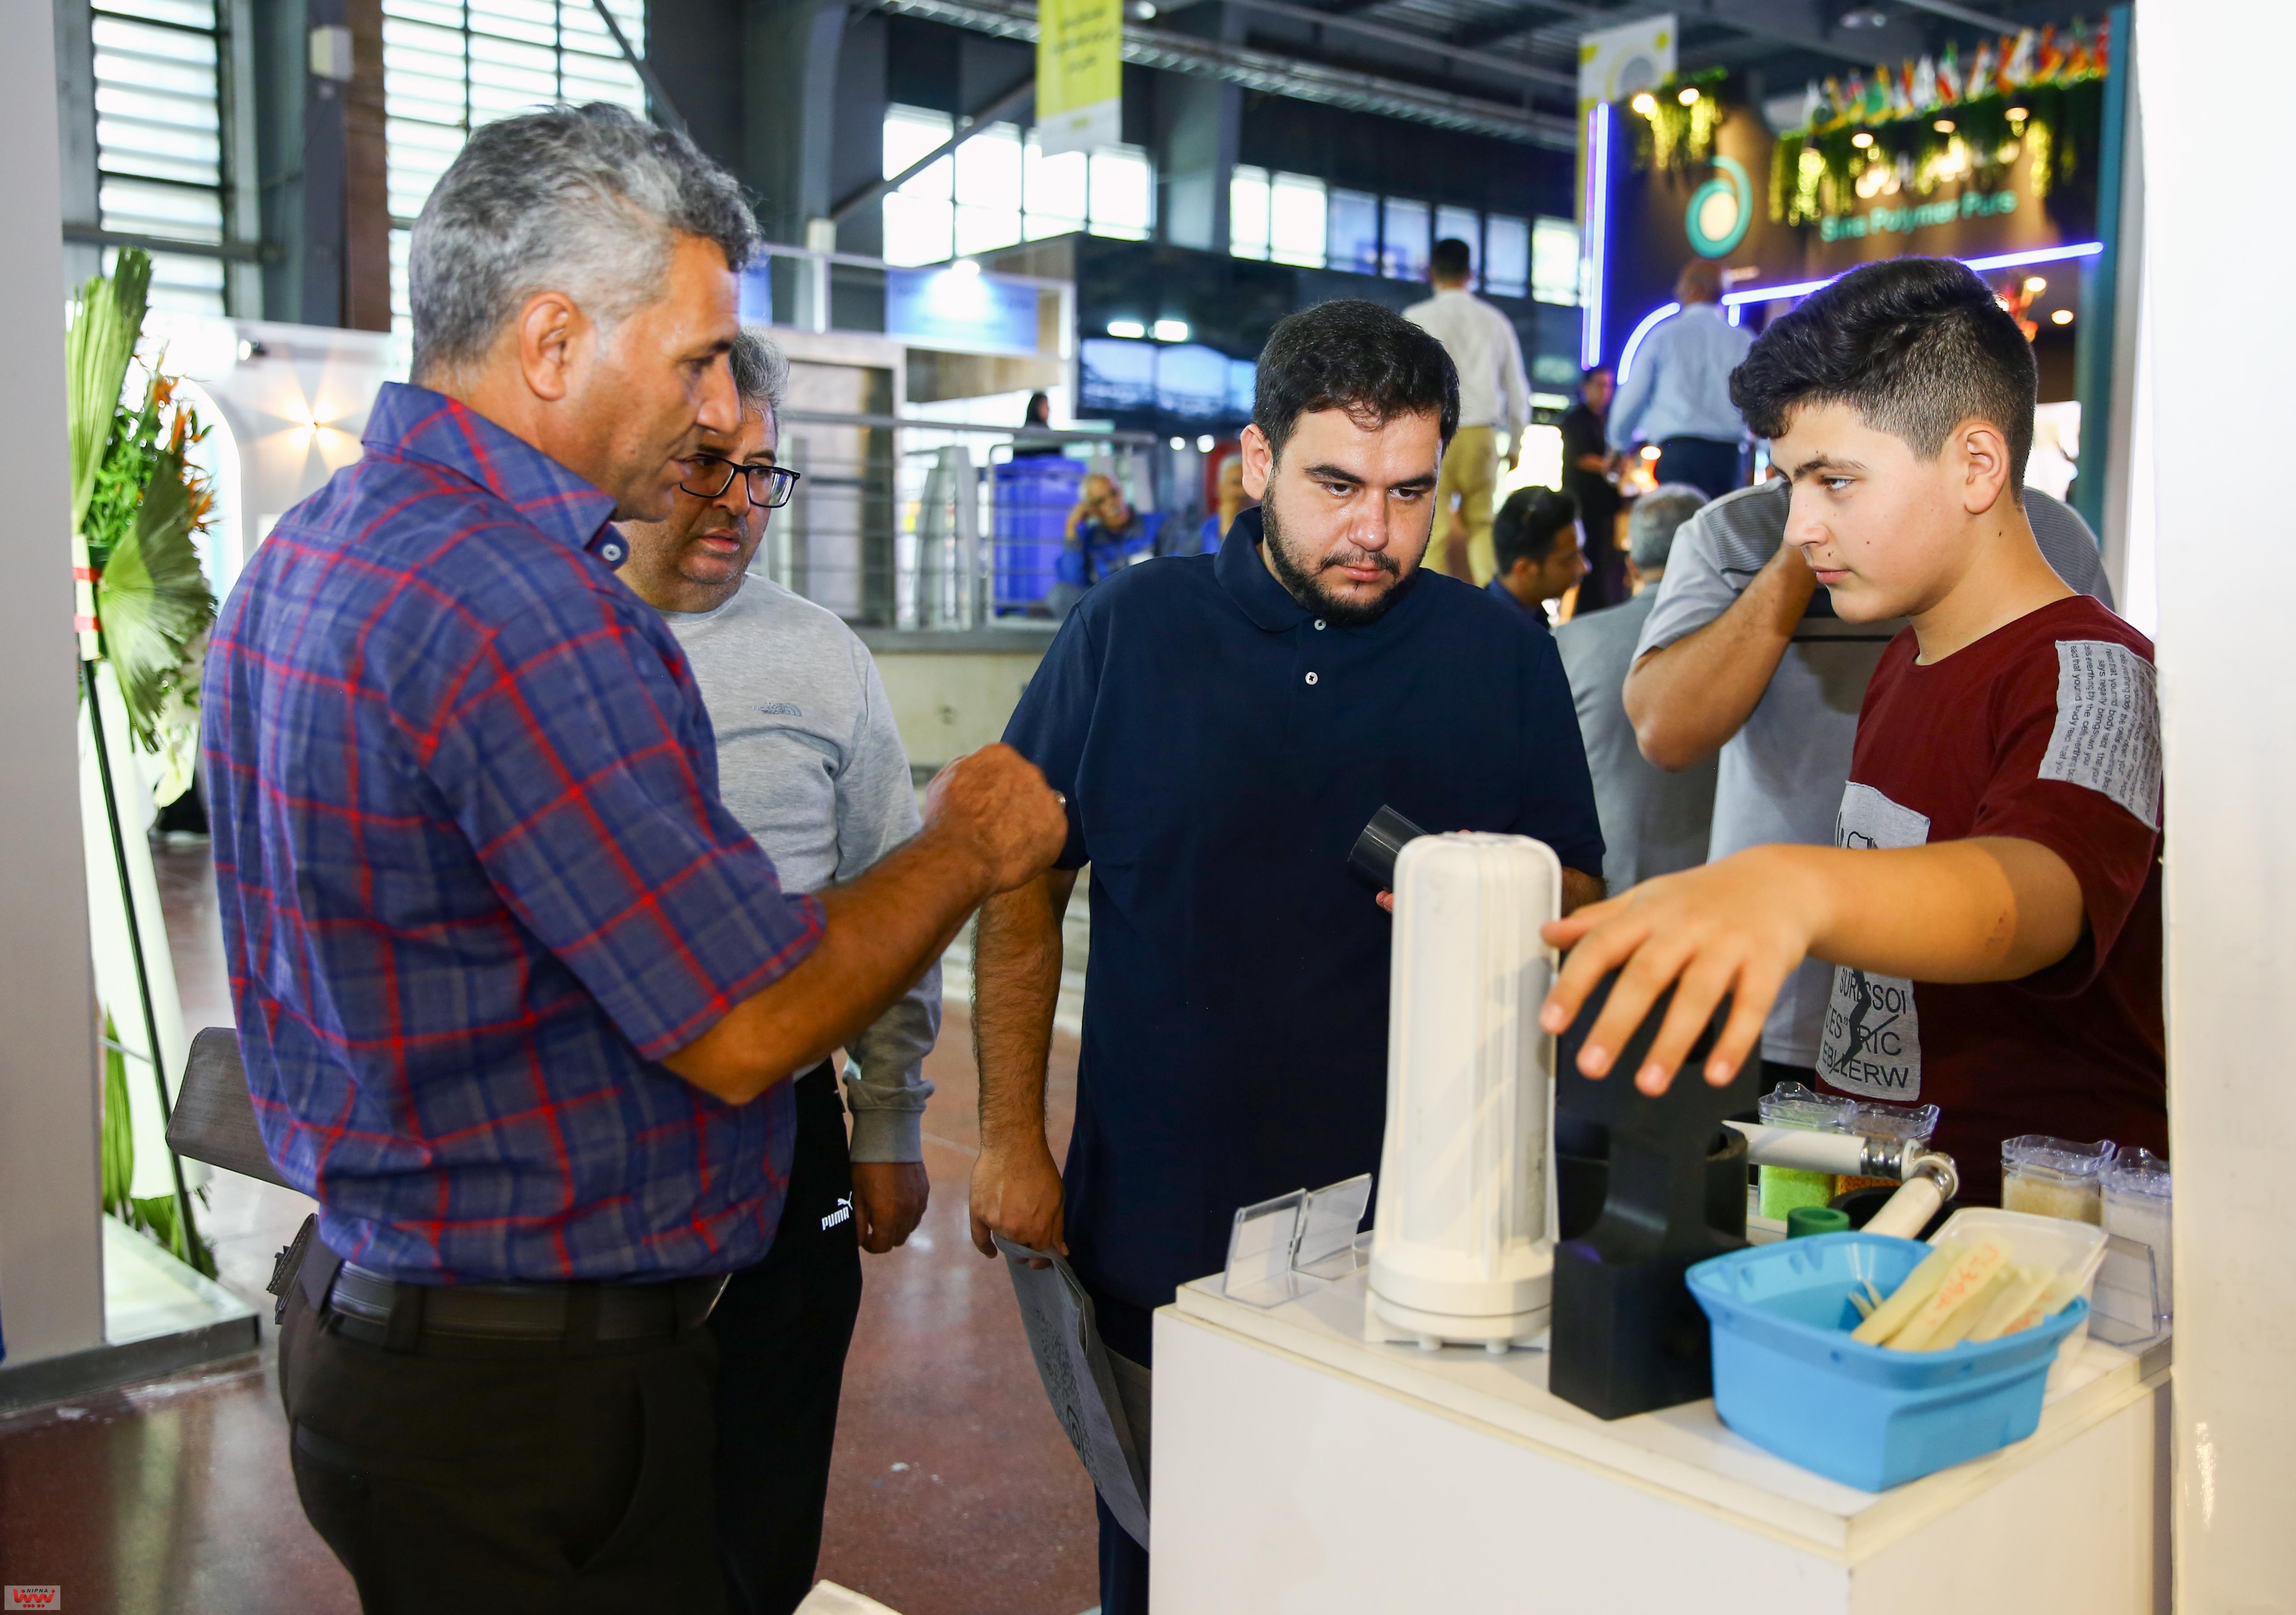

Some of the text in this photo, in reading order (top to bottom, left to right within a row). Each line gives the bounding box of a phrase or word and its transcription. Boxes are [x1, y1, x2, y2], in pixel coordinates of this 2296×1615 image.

[1870, 199, 1960, 235] Polymer
[2098, 660, 2106, 676] says
[2085, 704, 2093, 717] the
[2119, 714, 2127, 725] the
[2092, 708, 2105, 734] brings
[2104, 710, 2117, 731] body
[2083, 752, 2091, 766] your
[822, 1206, 849, 1230] PUMA
